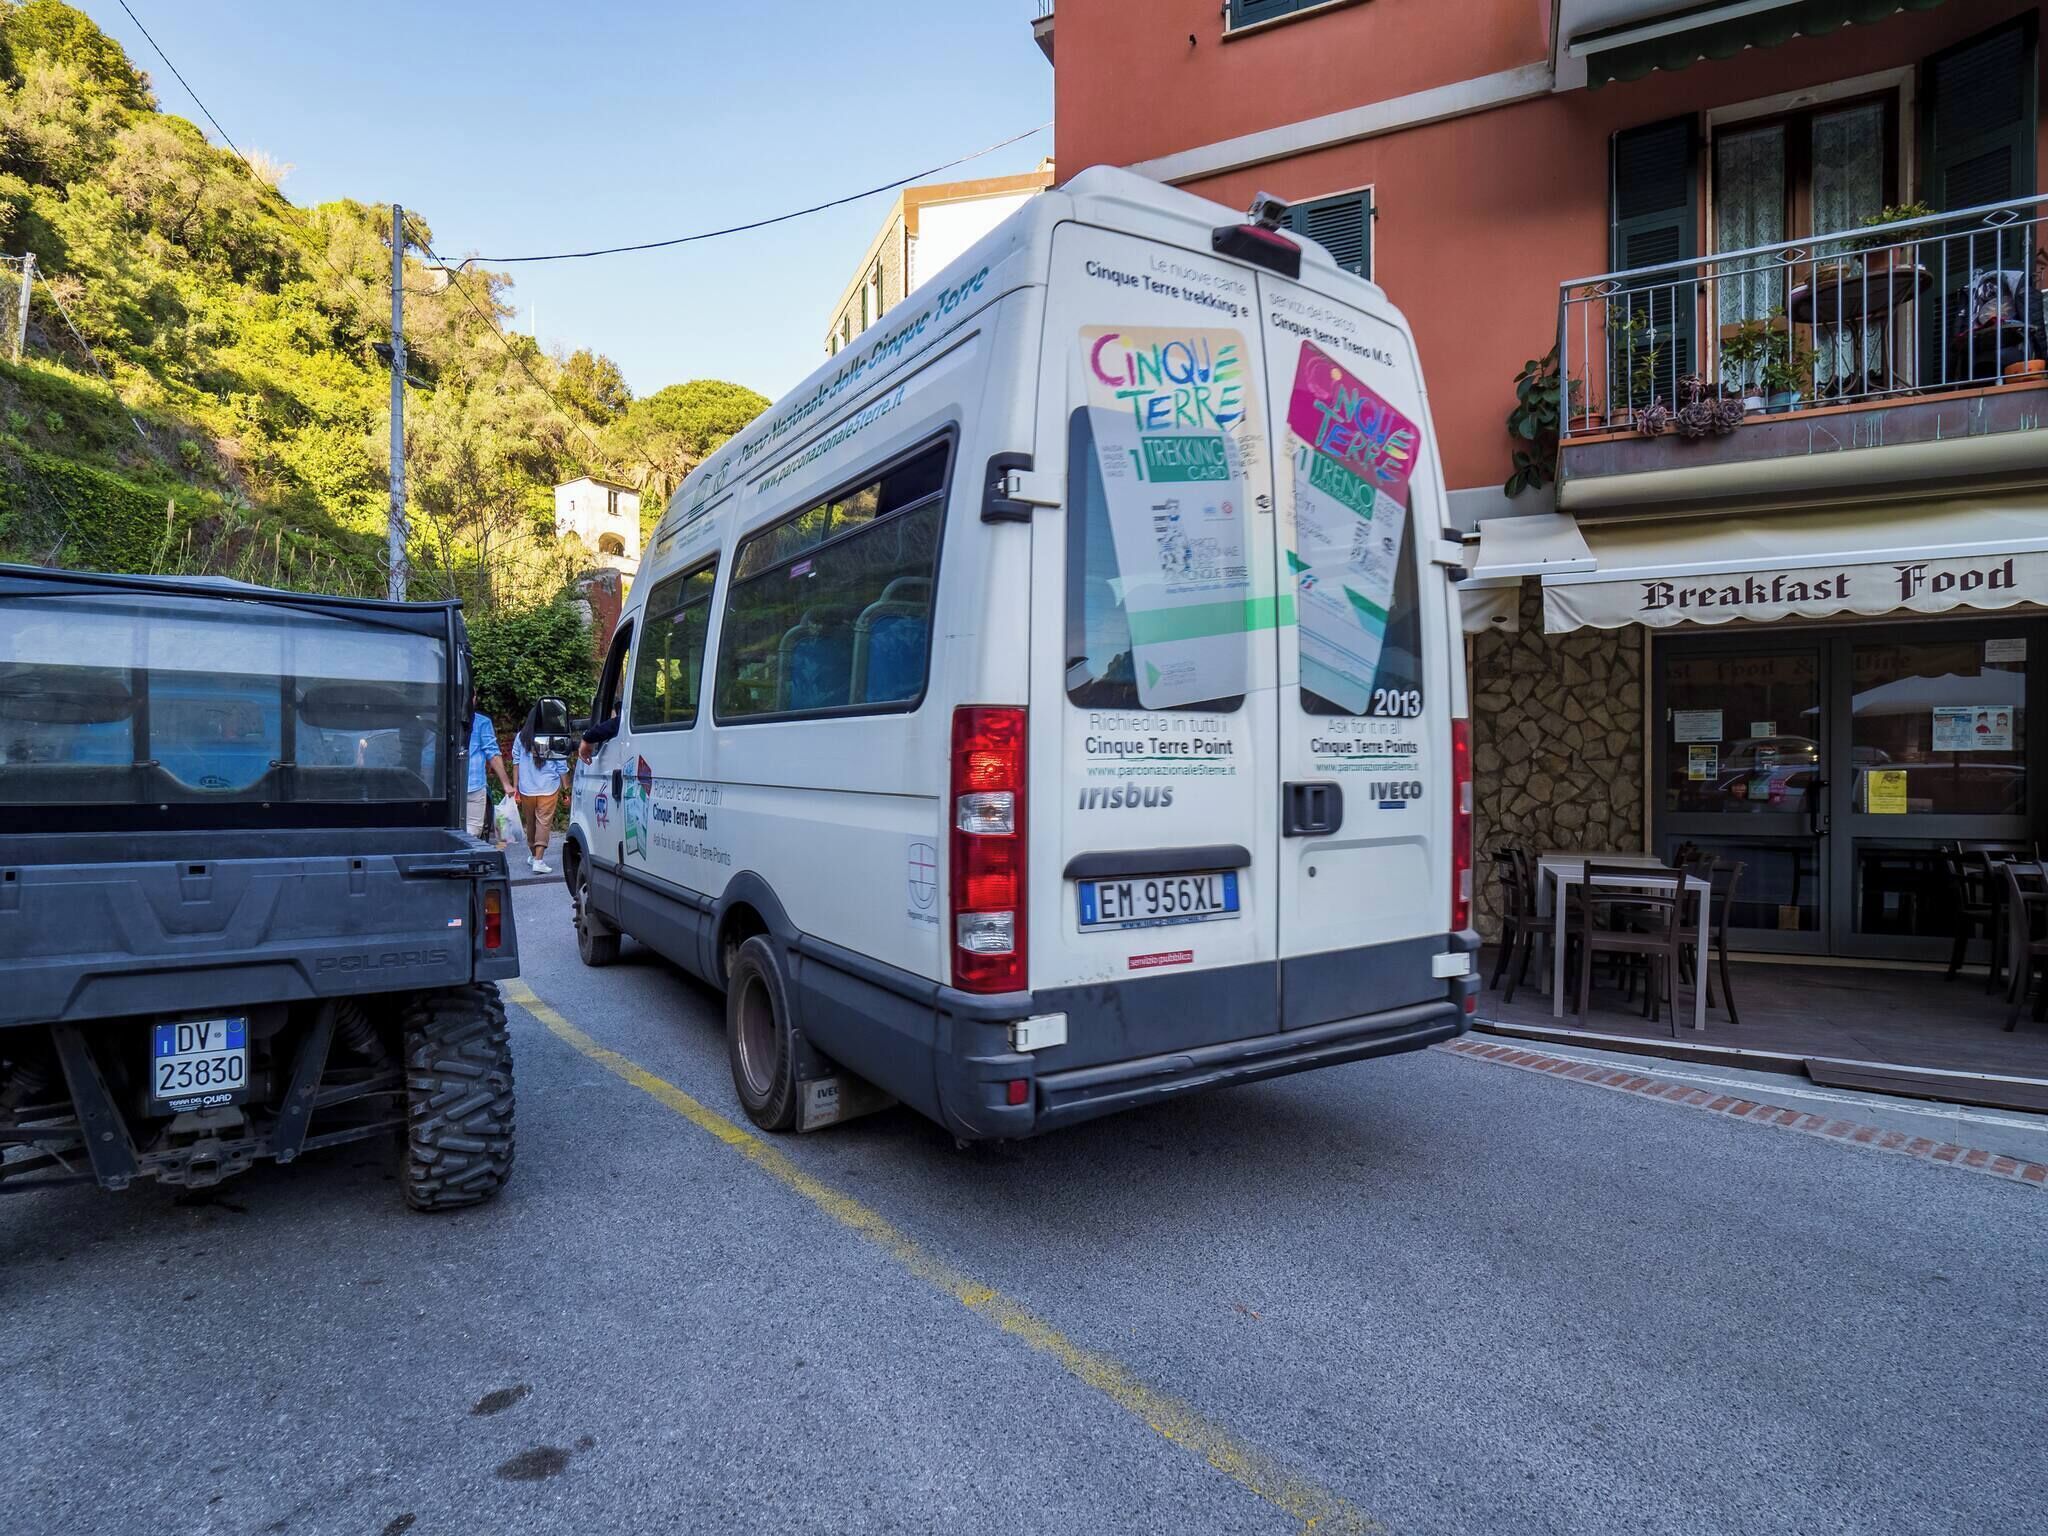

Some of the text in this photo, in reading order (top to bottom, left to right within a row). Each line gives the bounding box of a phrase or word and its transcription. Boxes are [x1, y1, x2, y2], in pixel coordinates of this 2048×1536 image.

[1085, 260, 1249, 318] Cinque Terre trekking e
[1271, 313, 1312, 337] Cinque
[738, 266, 989, 466] Parco Nazionale delle Cinque Terre
[1091, 333, 1243, 387] CINQUE
[1116, 385, 1246, 432] TERRE
[758, 385, 905, 495] www.parconazionale5terre.it
[1144, 438, 1225, 466] TREKKING
[1187, 465, 1227, 481] CARD
[1313, 453, 1373, 509] TRENO
[1639, 558, 2017, 611] Breakfast Food
[1373, 688, 1421, 717] 2013
[1171, 714, 1186, 732] in
[1085, 735, 1234, 759] Cinque Terre Point
[1311, 737, 1418, 757] Cinque Terre Points
[1078, 780, 1174, 810] irisbus
[1369, 781, 1423, 800] IVECO
[653, 803, 707, 831] Cinque Terre Point
[1101, 876, 1222, 919] EM 956XL
[315, 949, 449, 975] POLARIS
[178, 1022, 210, 1053] DV
[160, 1055, 243, 1091] 23830
[203, 1093, 232, 1105] QUAD
